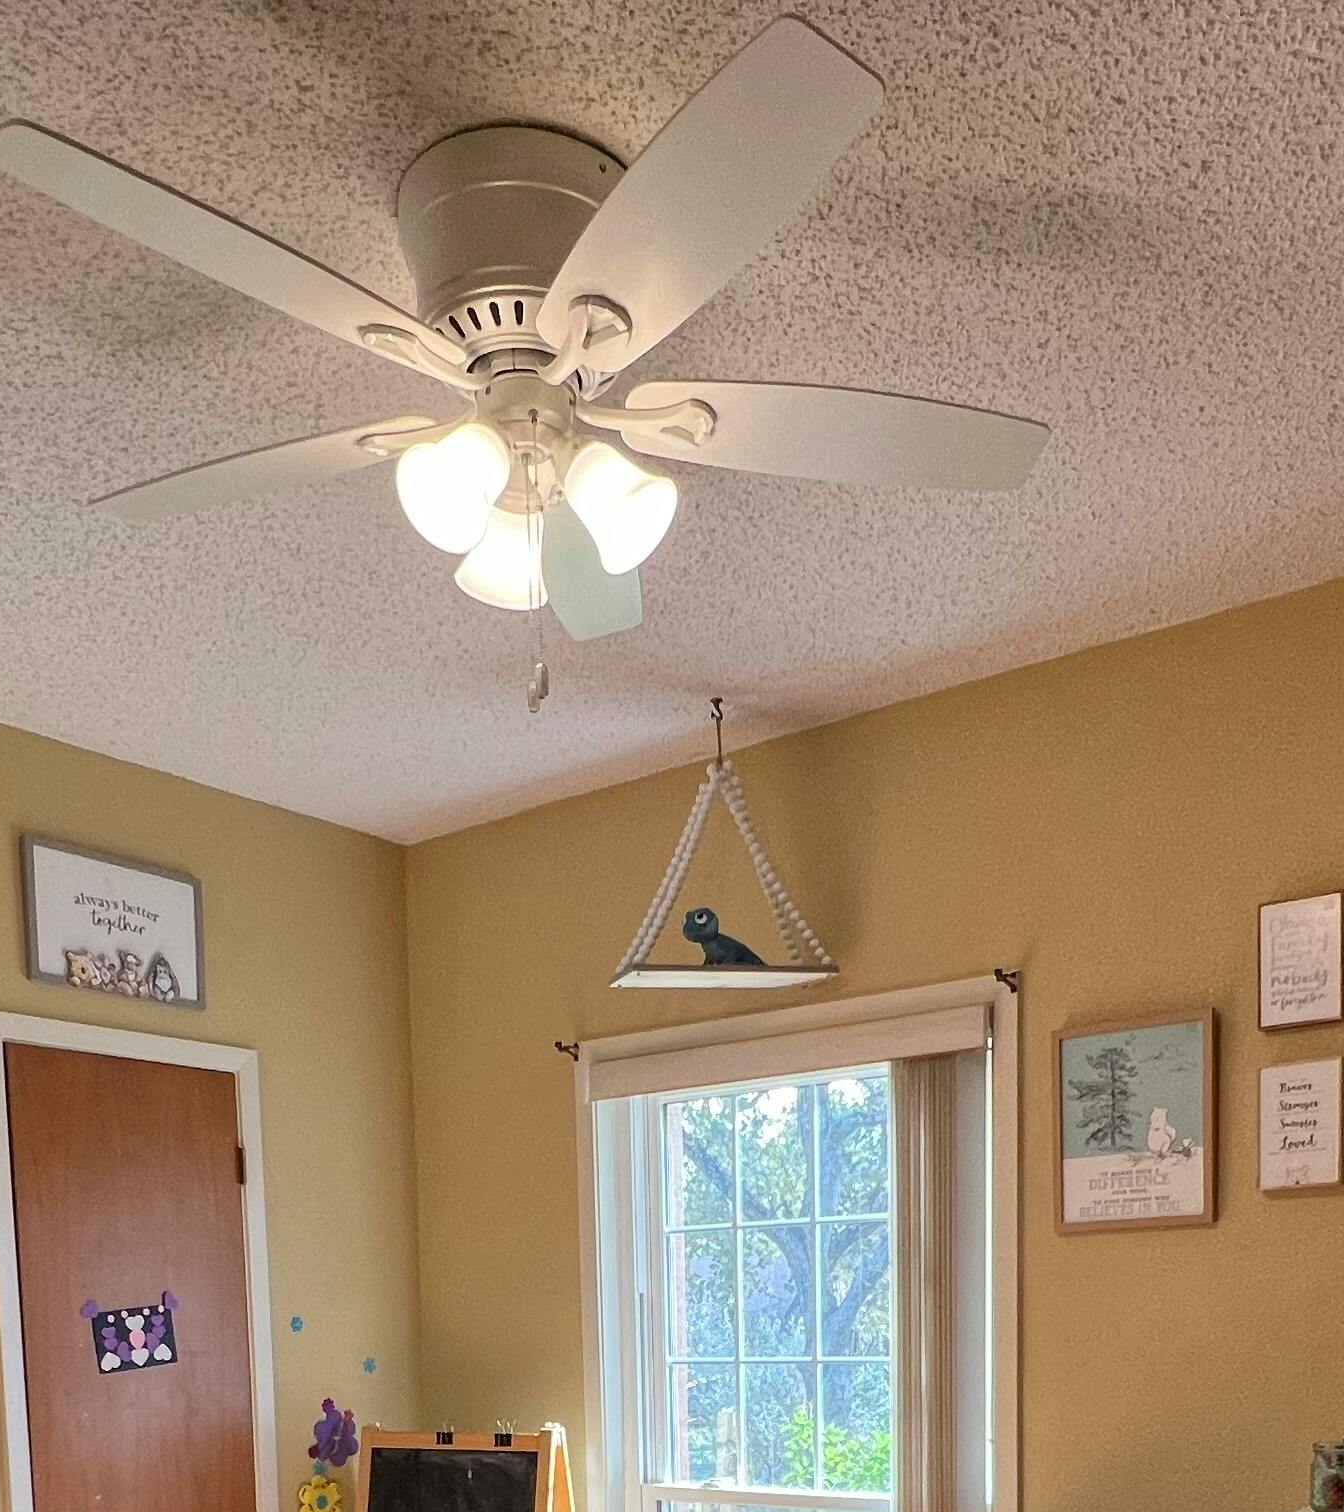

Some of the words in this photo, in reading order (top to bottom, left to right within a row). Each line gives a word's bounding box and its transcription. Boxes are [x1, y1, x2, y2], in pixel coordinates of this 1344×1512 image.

[74, 893, 119, 912] always
[122, 900, 160, 922] better
[91, 909, 146, 935] together
[1280, 1133, 1316, 1150] Loved
[1089, 1173, 1169, 1190] DIFFERENCE
[1079, 1204, 1133, 1217] BELIEVES
